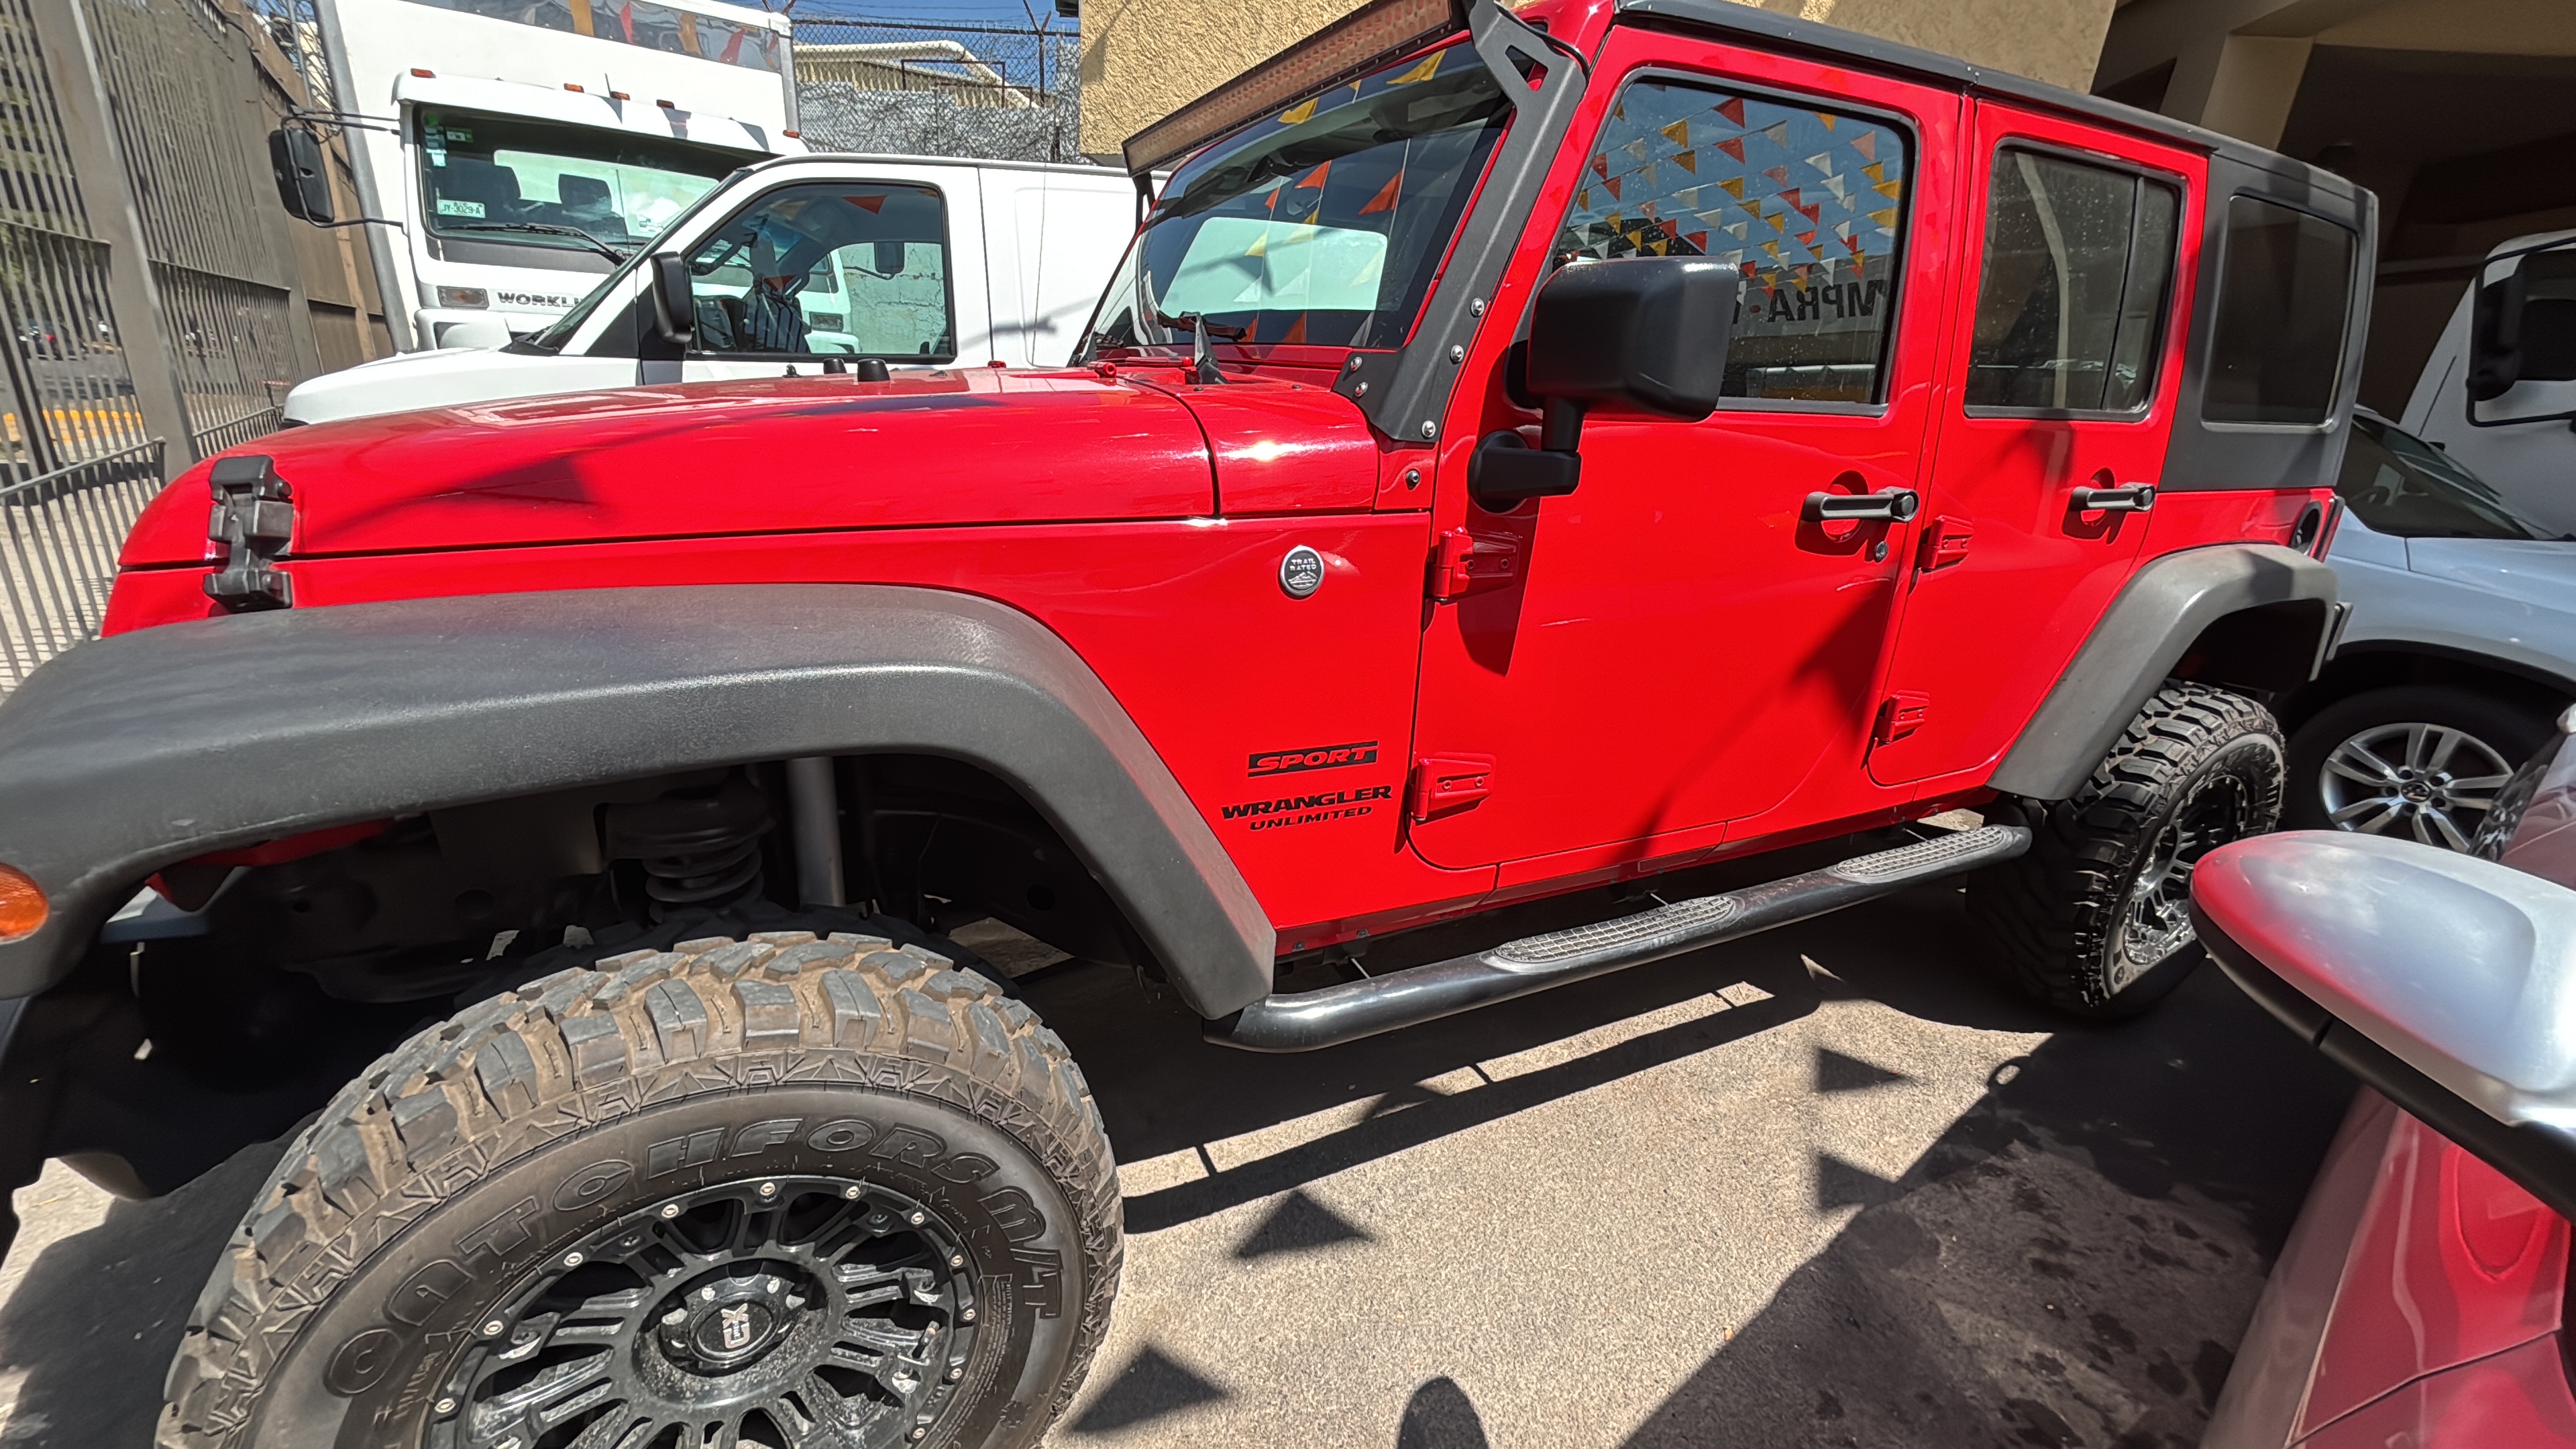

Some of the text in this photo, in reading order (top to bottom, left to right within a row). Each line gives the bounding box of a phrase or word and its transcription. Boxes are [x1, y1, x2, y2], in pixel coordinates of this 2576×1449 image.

[497, 292, 584, 307] WORKLI
[1256, 745, 1378, 770] SPORT
[1221, 785, 1392, 820] WRANGLER
[1250, 806, 1372, 830] UNLIMITED
